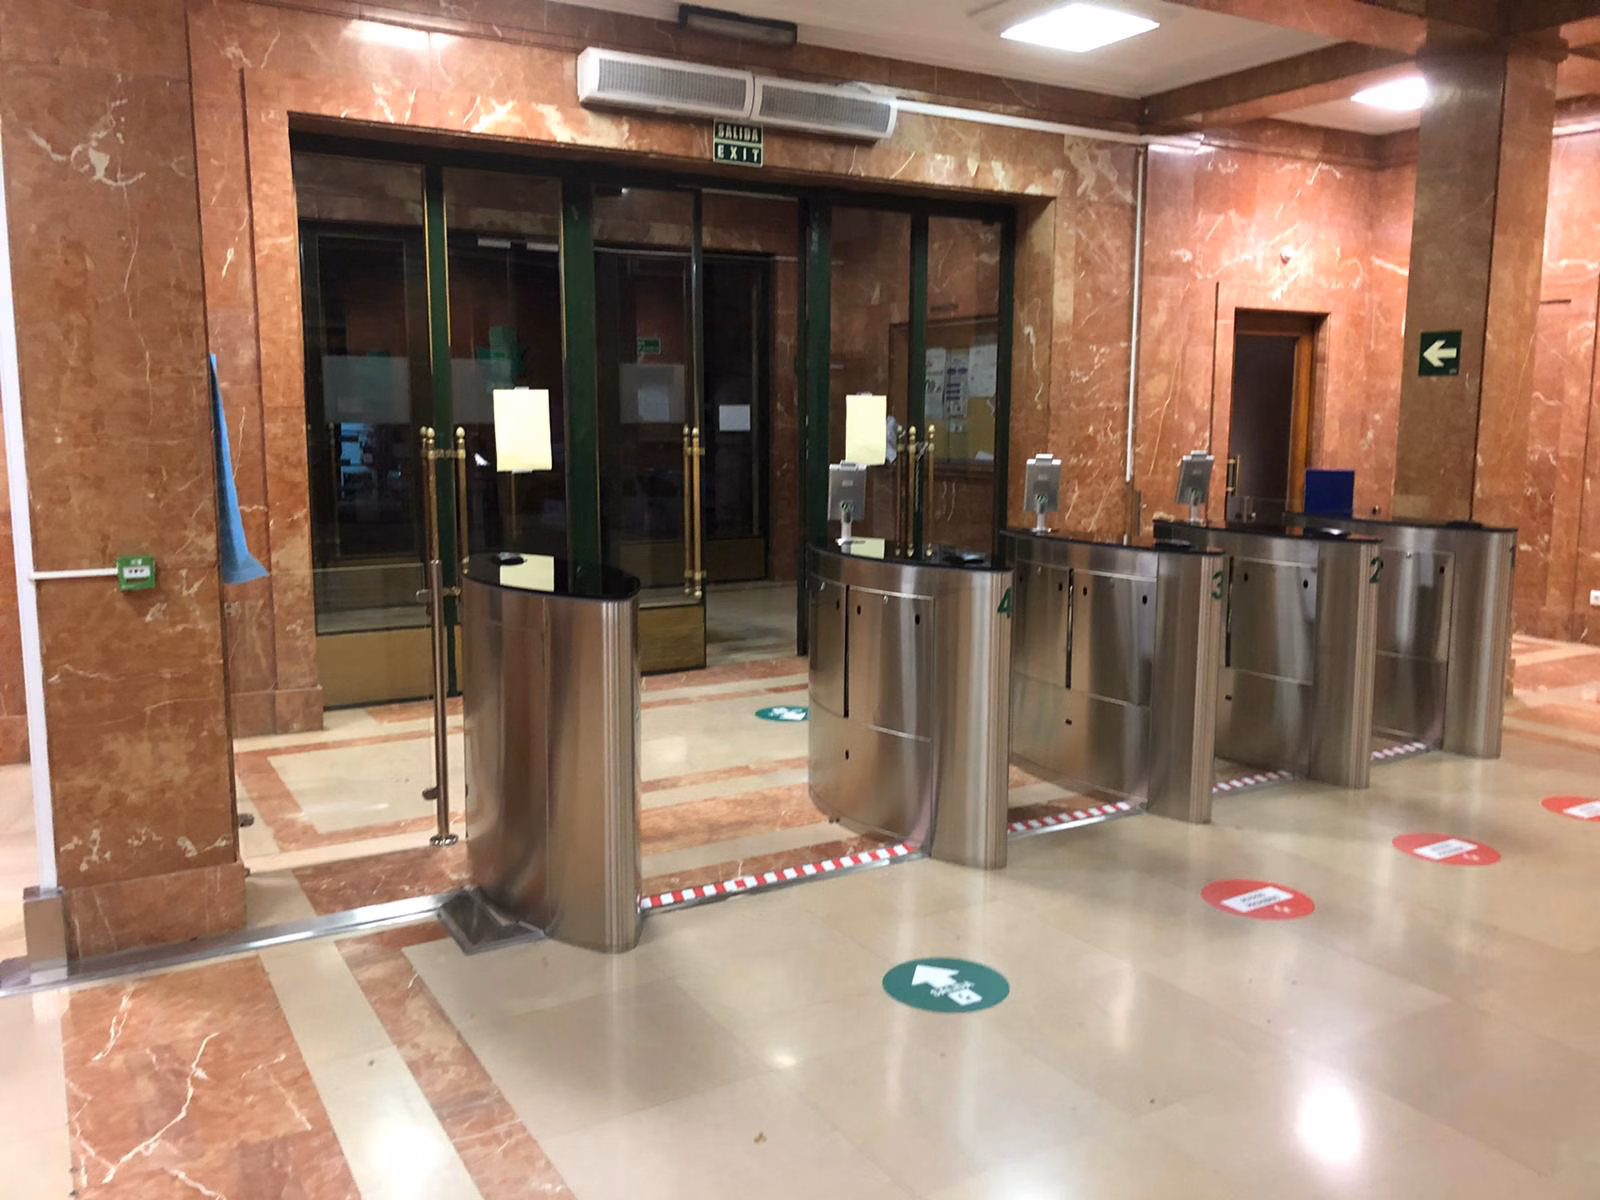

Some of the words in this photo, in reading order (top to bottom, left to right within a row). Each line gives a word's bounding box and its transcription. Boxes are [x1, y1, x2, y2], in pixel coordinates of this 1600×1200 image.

[718, 123, 759, 143] SALIDA
[717, 144, 760, 162] EXIT
[1370, 556, 1382, 584] 2
[1212, 571, 1224, 600] 3
[997, 587, 1013, 619] 4
